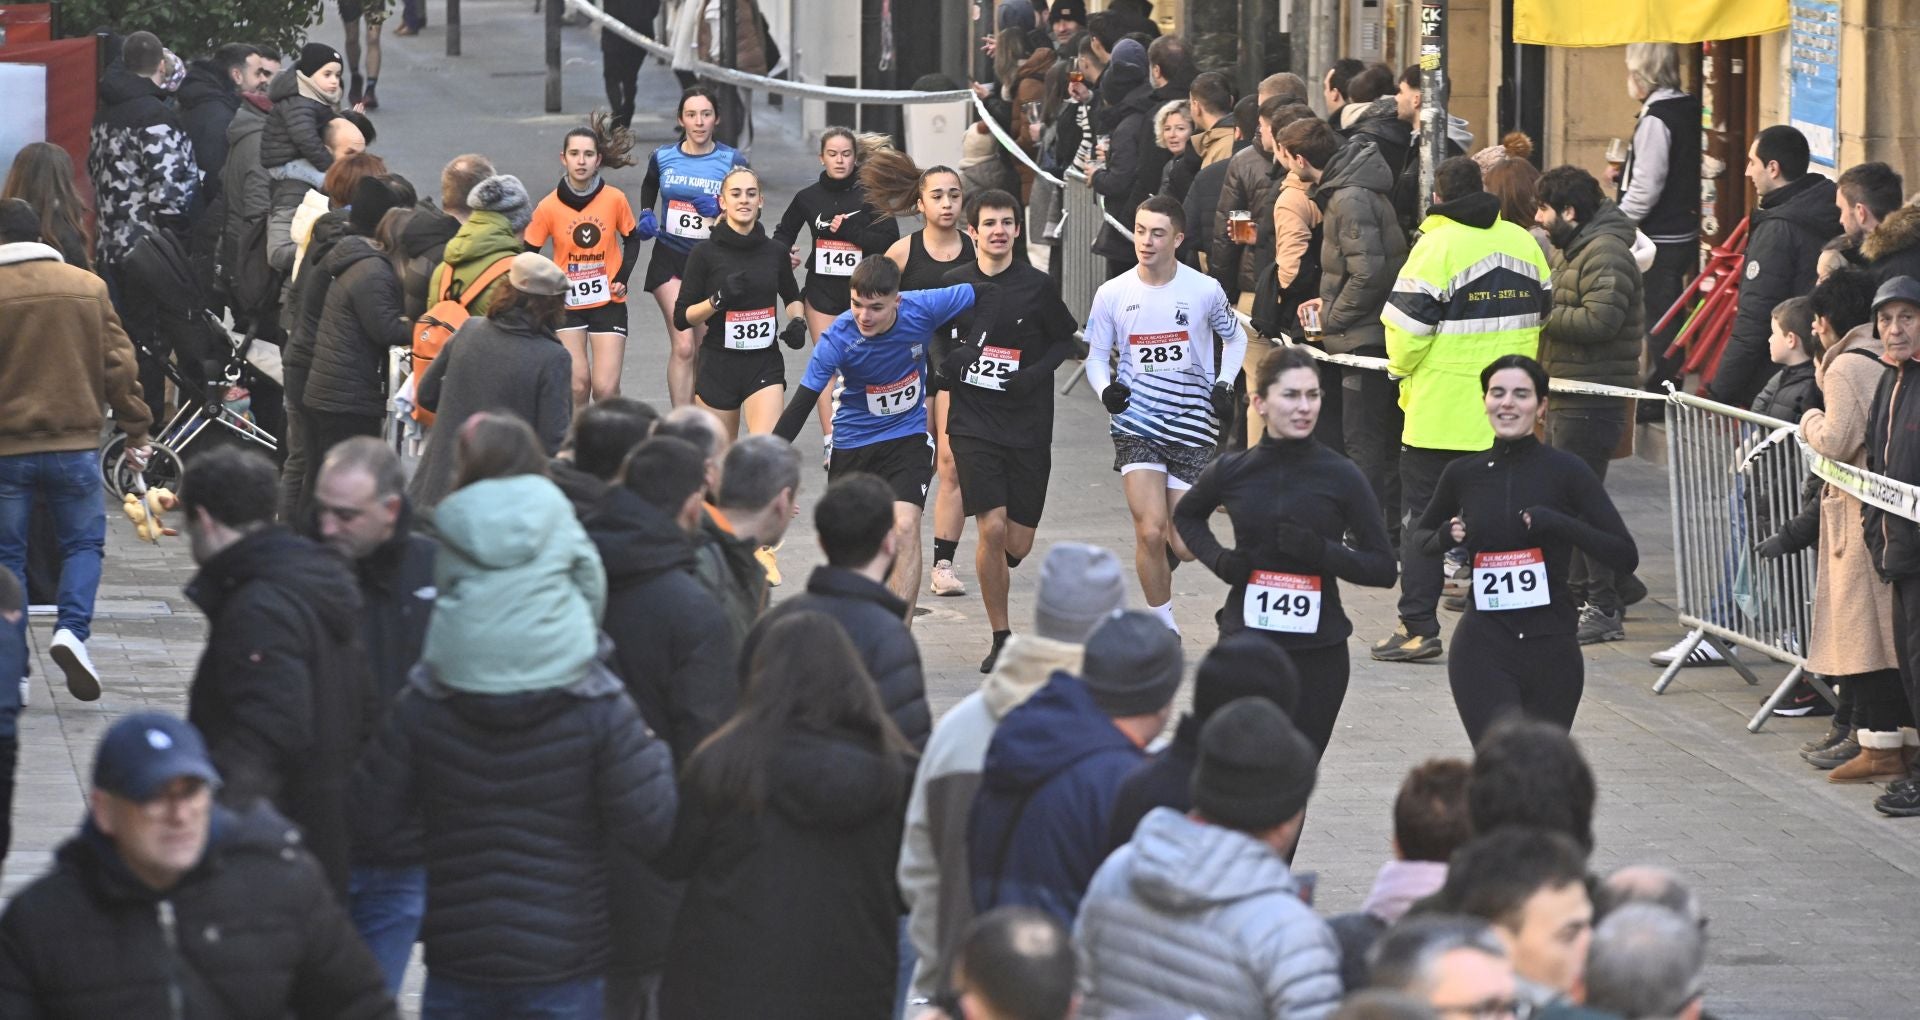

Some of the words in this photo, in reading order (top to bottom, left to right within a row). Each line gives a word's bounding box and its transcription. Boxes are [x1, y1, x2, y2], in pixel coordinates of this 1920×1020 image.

[665, 174, 688, 186] ZAZPI
[679, 213, 703, 230] 63
[568, 250, 605, 262] hummel
[823, 251, 856, 267] 146
[571, 279, 603, 297] 195
[1468, 291, 1490, 302] BETI
[733, 321, 770, 340] 382
[1139, 344, 1183, 364] 283
[968, 359, 1010, 379] 325
[876, 385, 916, 407] 179
[1482, 569, 1537, 595] 219
[1257, 591, 1311, 617] 149
